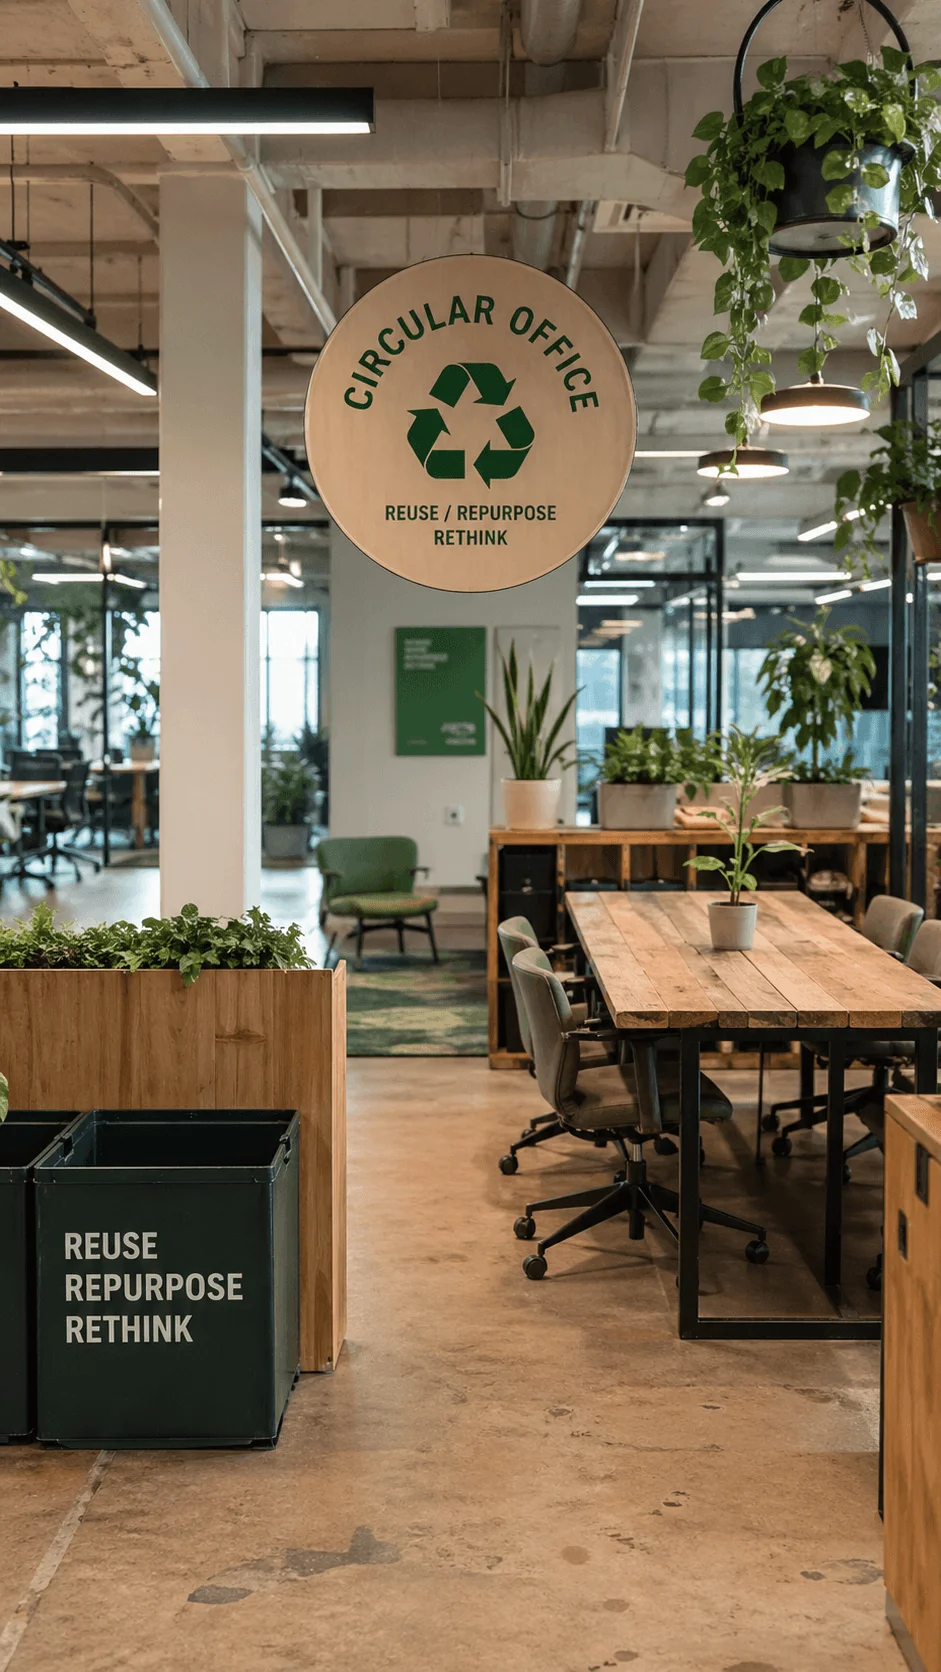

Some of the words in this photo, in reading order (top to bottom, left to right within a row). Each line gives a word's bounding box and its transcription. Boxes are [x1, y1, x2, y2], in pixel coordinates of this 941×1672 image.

[343, 295, 496, 411] CIRCULAR
[508, 305, 600, 413] OFFICE
[385, 505, 439, 521] REUSE
[444, 504, 451, 523] /
[457, 505, 557, 521] REPURPOSE
[434, 530, 508, 546] RETHINK
[64, 1231, 158, 1260] REUSE
[65, 1272, 244, 1302] REPURPOSE
[66, 1314, 194, 1344] RETHINK
